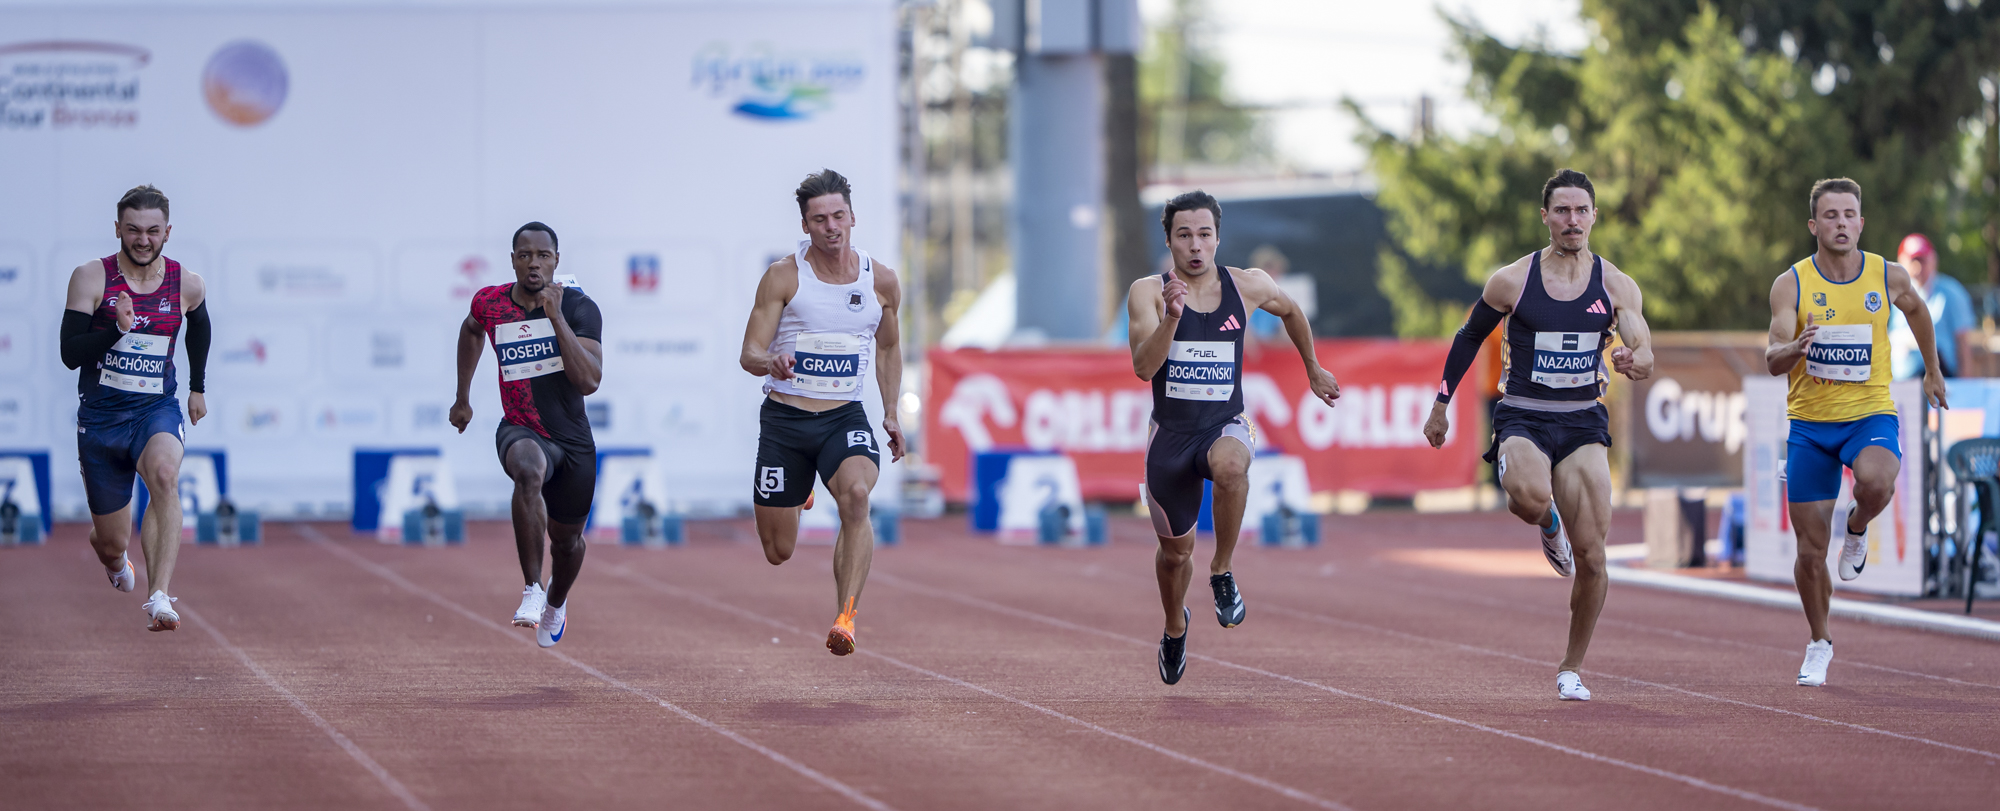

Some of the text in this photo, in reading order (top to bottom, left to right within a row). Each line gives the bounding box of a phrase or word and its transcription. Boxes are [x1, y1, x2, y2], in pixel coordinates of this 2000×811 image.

[501, 341, 554, 361] JOSEPH
[1193, 350, 1217, 358] FUEL
[1808, 346, 1869, 362] WYKROTA
[105, 352, 164, 373] BACHÓRSKI
[802, 357, 852, 372] GRAVA
[1537, 354, 1595, 370] NAZAROV
[1168, 363, 1232, 380] BOGACZYŃSKI
[852, 431, 867, 443] 5
[765, 469, 779, 490] 5
